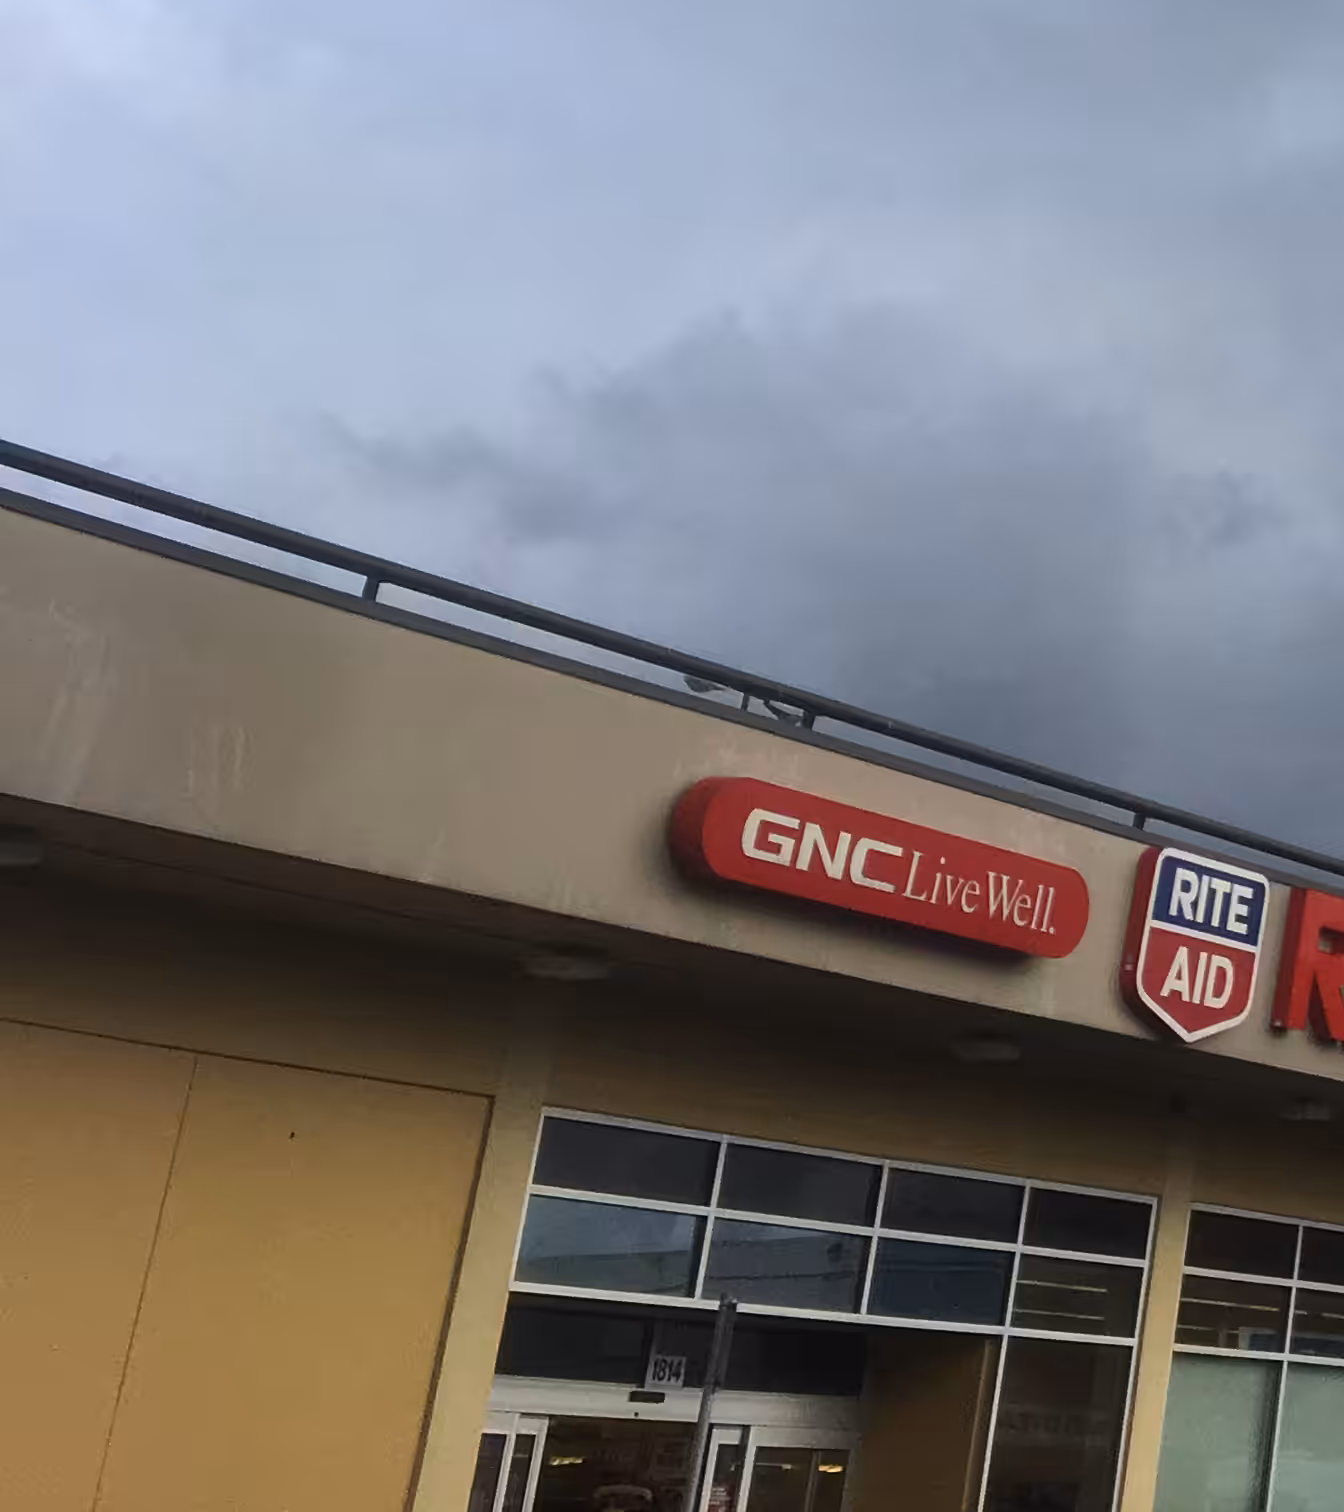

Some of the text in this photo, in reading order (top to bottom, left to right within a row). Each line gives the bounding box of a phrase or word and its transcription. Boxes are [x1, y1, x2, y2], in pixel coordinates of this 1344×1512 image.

[741, 808, 904, 894] GNC
[902, 851, 980, 914] Live
[1169, 867, 1255, 935] RITE
[1160, 946, 1235, 1009] AID
[651, 1358, 683, 1384] 1814
